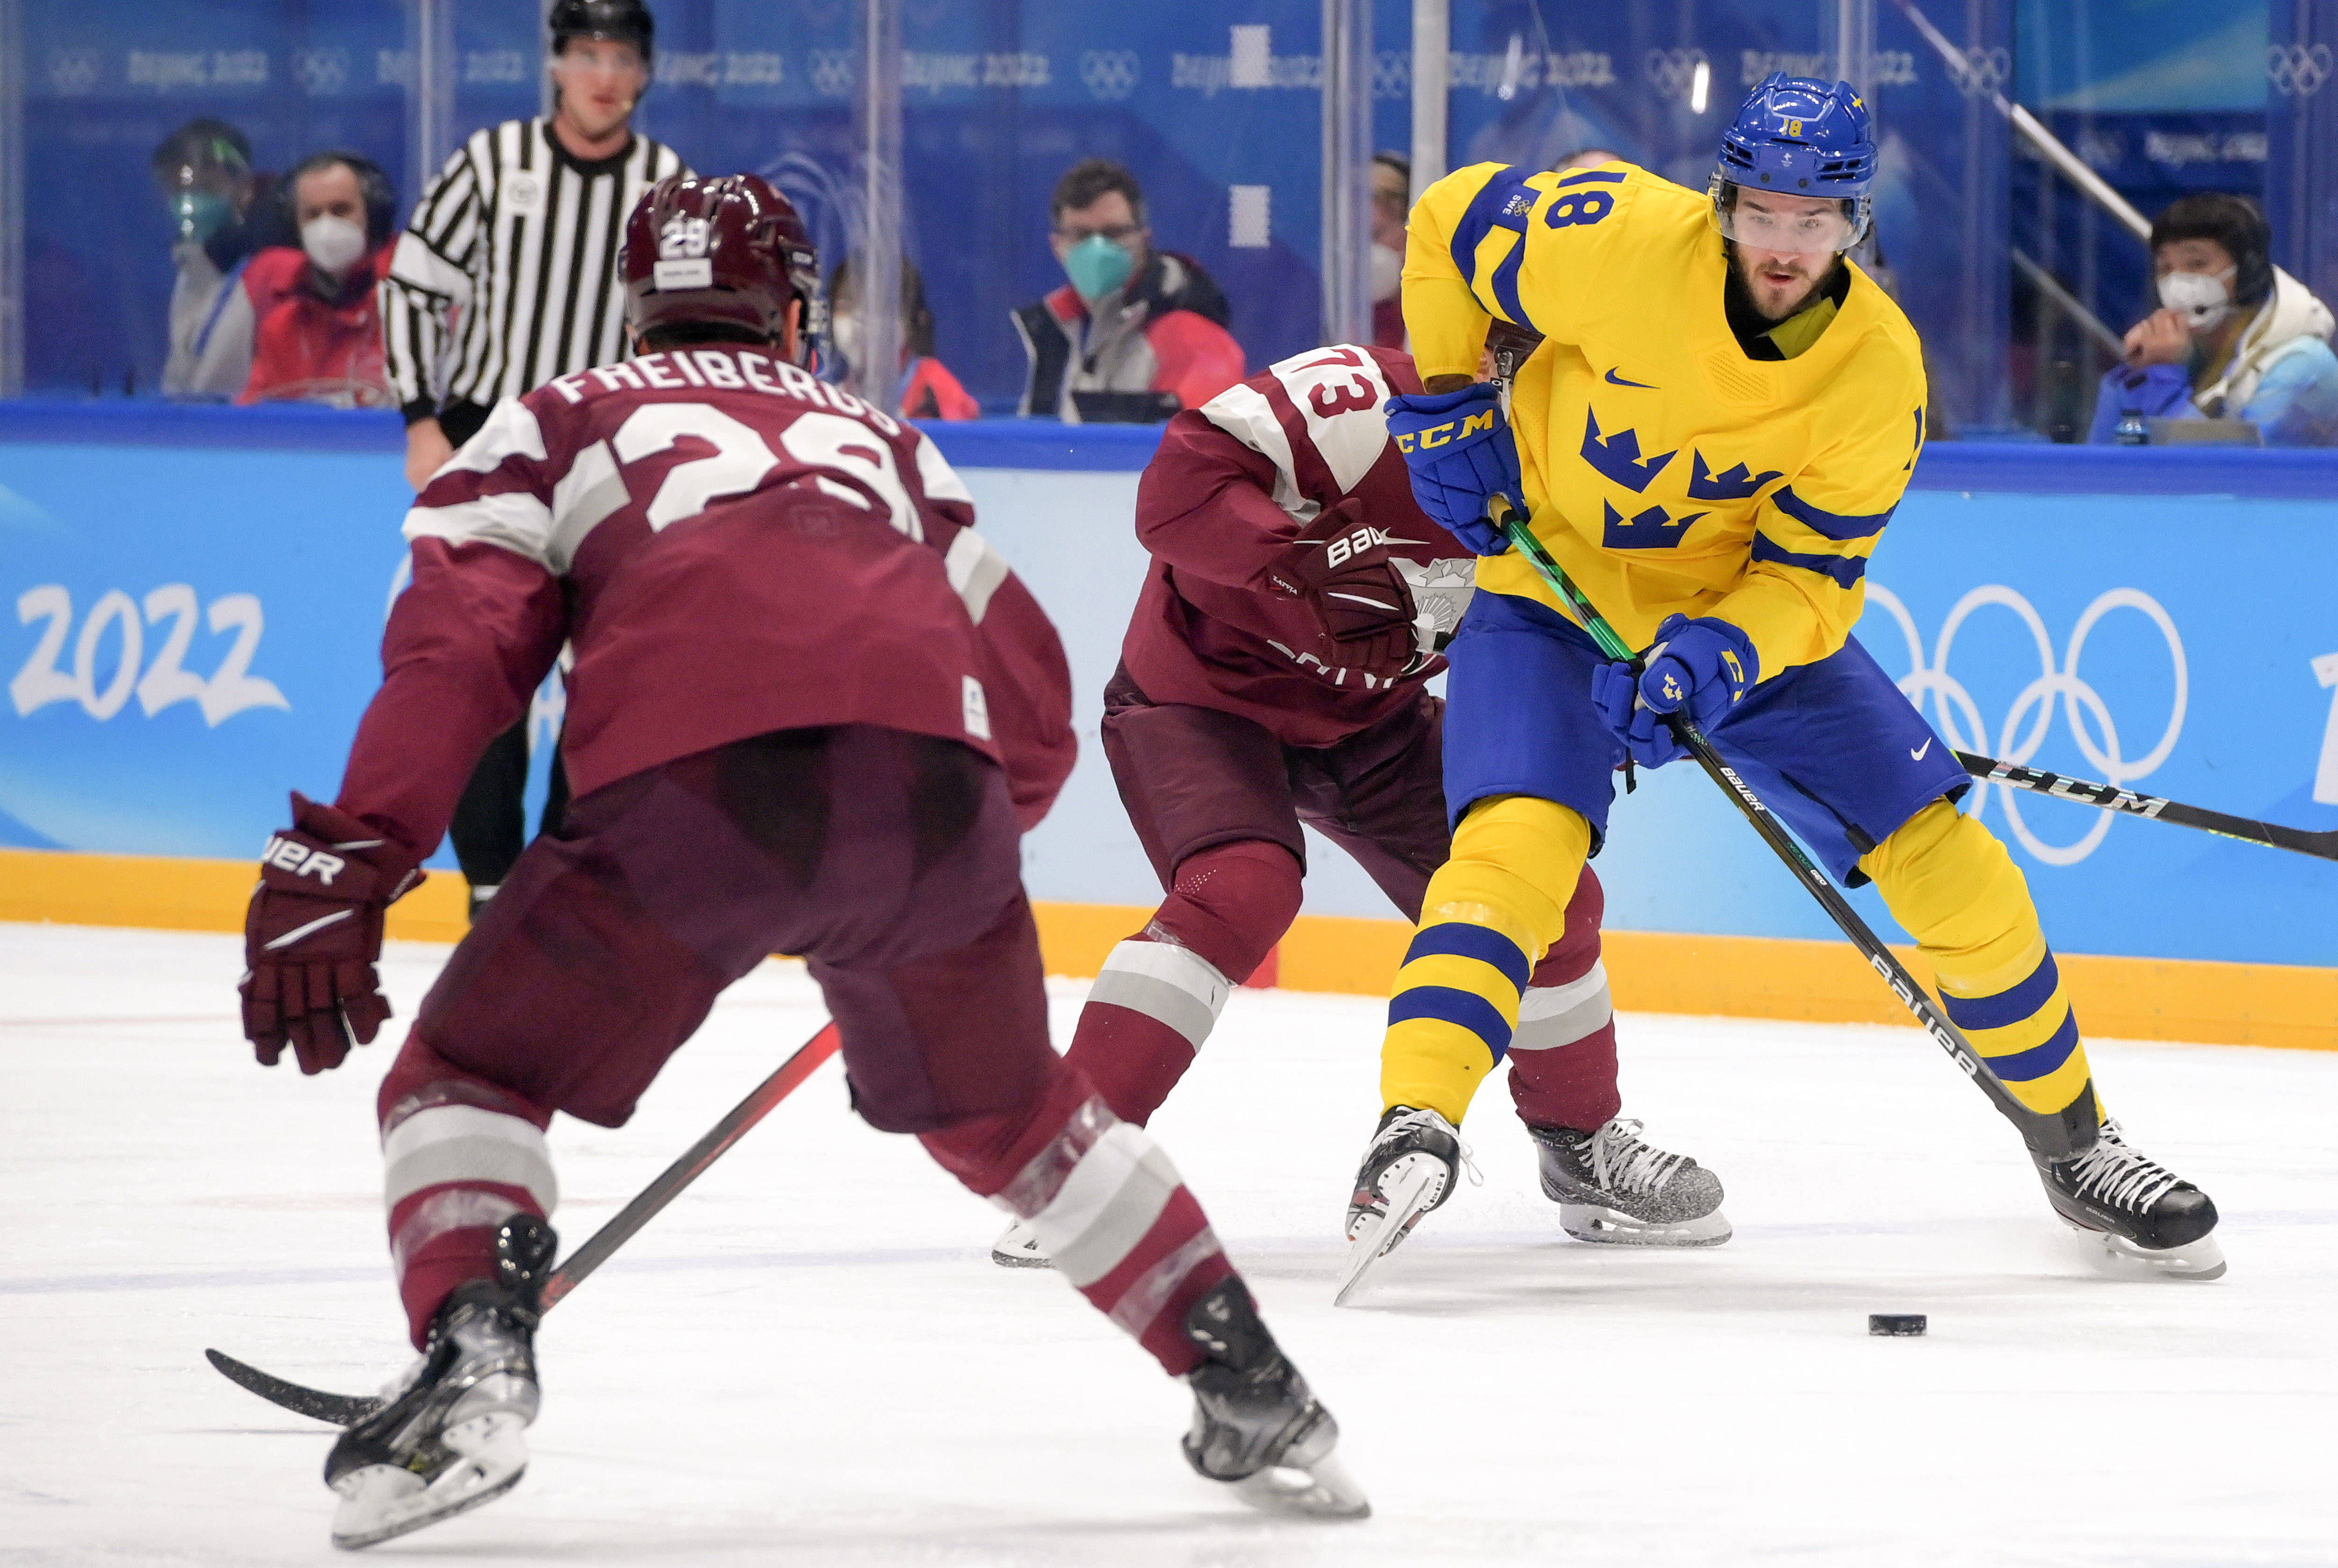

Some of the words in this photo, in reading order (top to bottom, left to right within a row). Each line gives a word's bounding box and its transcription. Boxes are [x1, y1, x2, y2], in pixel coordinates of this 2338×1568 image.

[1779, 118, 1803, 137] 18
[1502, 194, 1522, 216] SWE
[1544, 170, 1628, 230] 18
[660, 217, 710, 259] 29
[550, 350, 901, 436] FREIBERGS
[1289, 348, 1378, 419] 73
[1396, 409, 1494, 453] CCM
[612, 402, 924, 544] 29
[8, 583, 292, 729] 2022
[1719, 767, 1766, 812] BAUER
[1987, 760, 2170, 818] CCM
